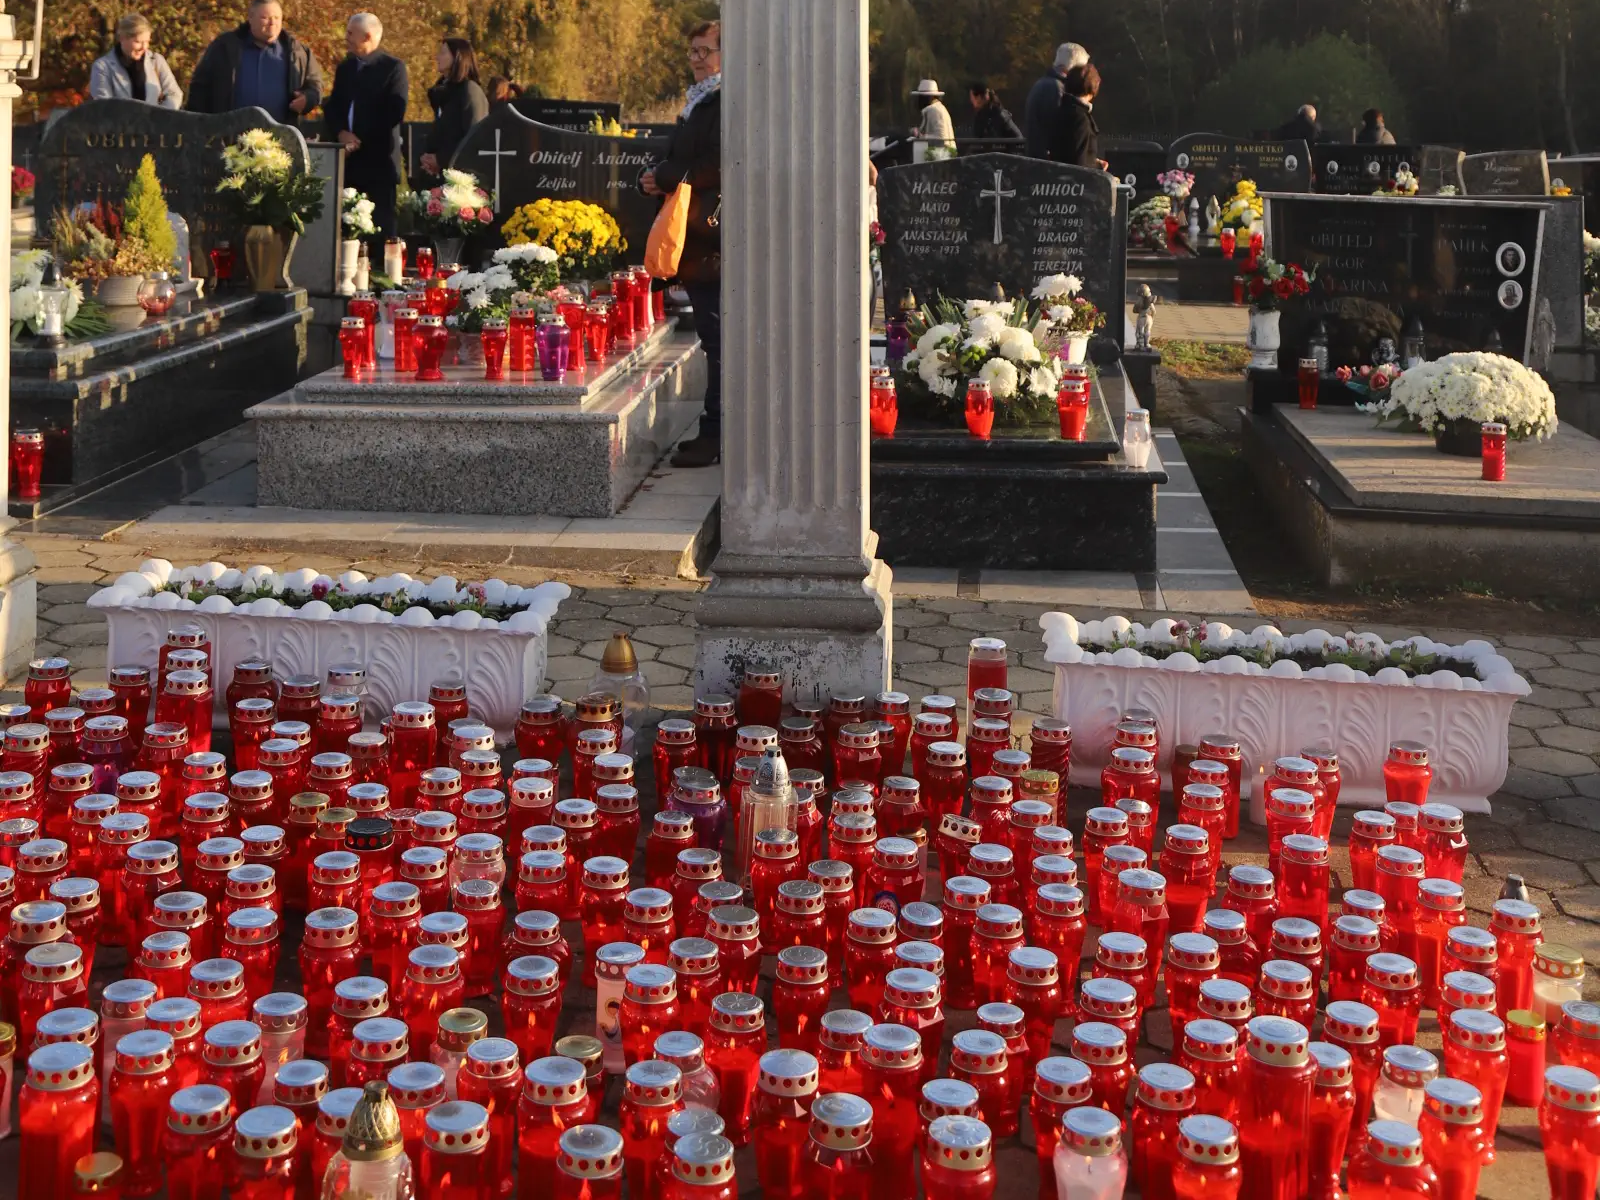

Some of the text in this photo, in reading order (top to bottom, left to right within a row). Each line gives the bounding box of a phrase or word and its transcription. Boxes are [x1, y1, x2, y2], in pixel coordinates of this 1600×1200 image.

[528, 150, 583, 168] Obitelj
[535, 174, 576, 191] Željko
[911, 182, 958, 195] HALEC
[1032, 183, 1085, 197] MIHOCI
[919, 202, 950, 213] MATO
[1039, 203, 1077, 214] VLADO
[901, 230, 968, 243] ANASTAZIJA
[1037, 231, 1077, 243] DRAGO
[1032, 260, 1083, 273] TEREZIJA
